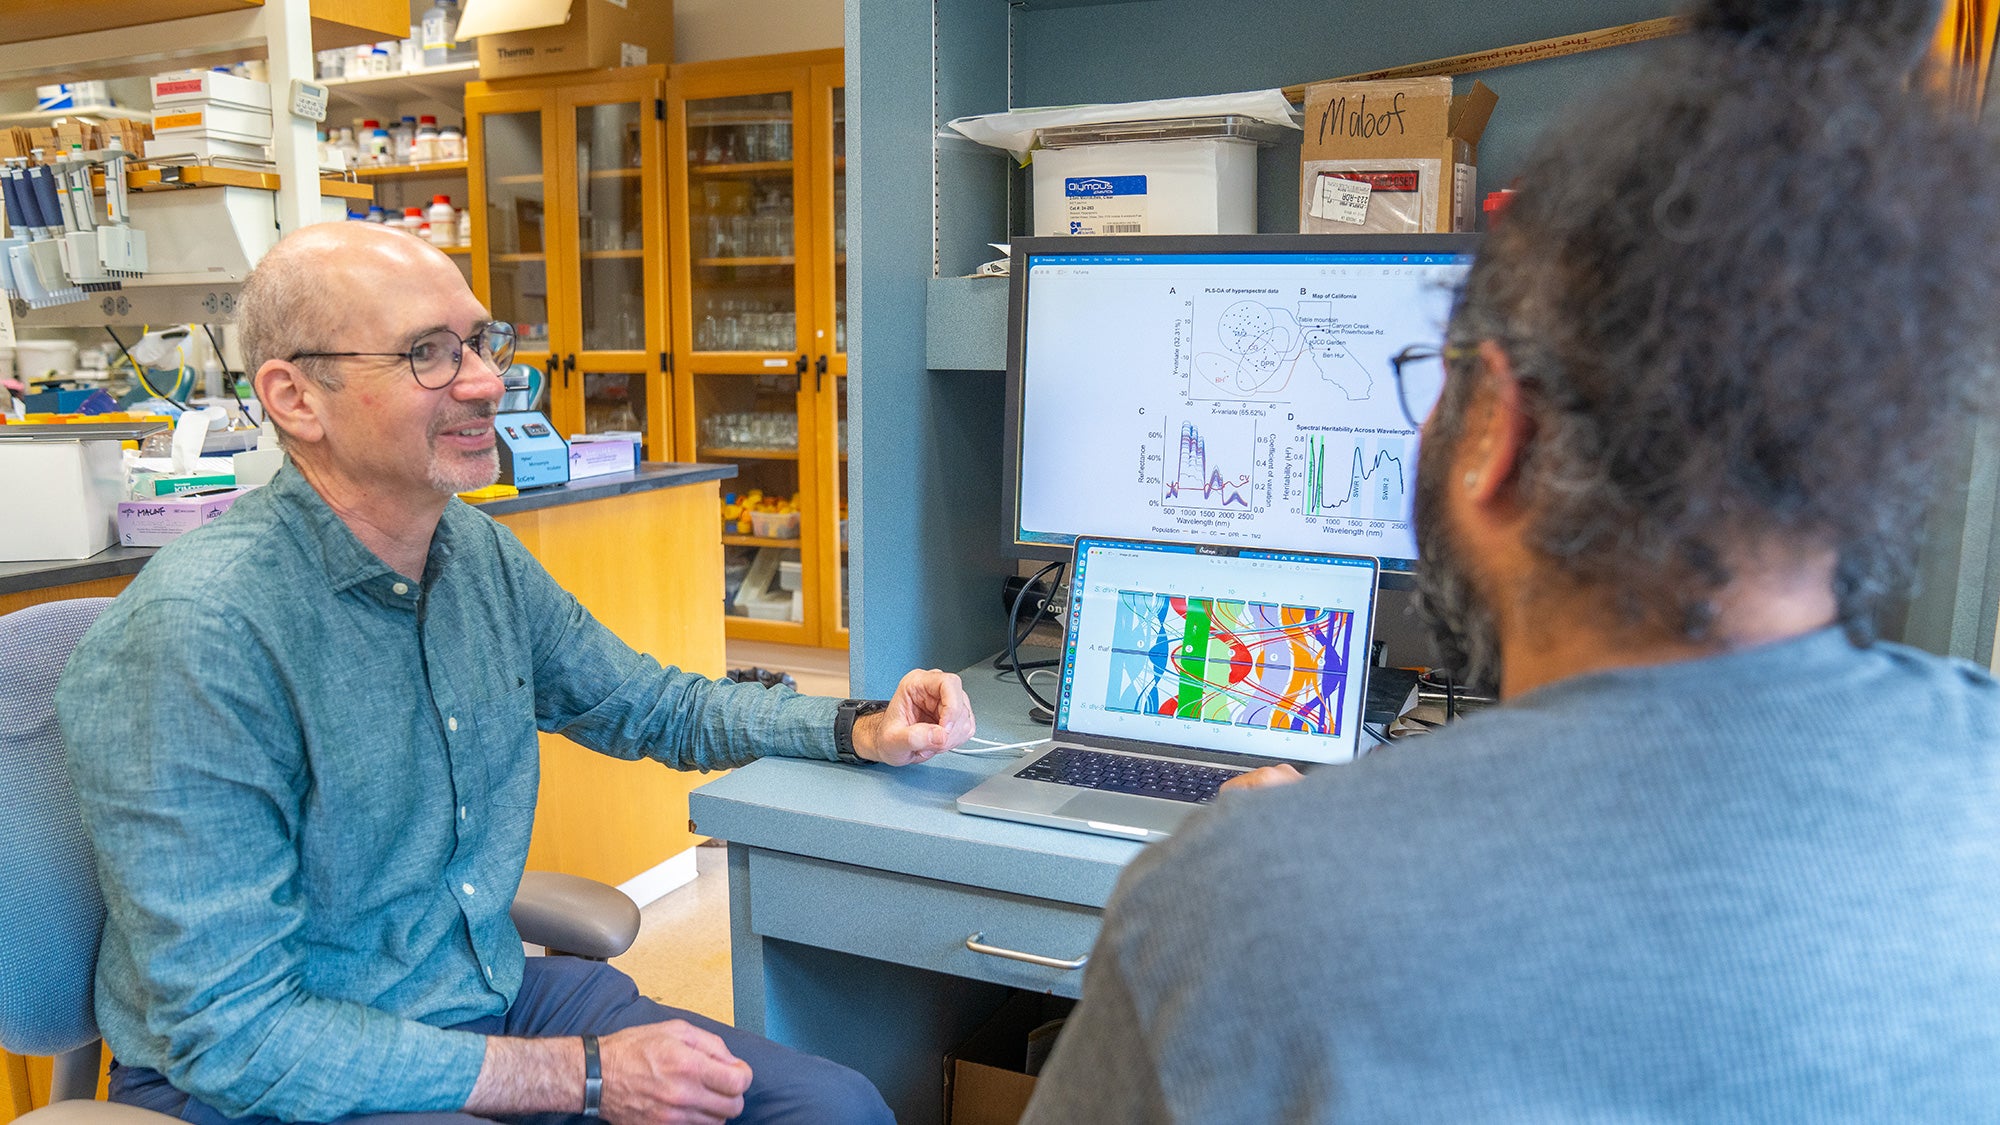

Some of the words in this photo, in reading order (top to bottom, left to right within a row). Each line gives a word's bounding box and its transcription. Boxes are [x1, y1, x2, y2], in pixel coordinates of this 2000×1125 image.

[497, 48, 534, 58] Thermo
[1068, 181, 1114, 192] Olympus
[1374, 176, 1414, 186] ENCLOSED
[1283, 462, 1292, 500] Heritability
[1176, 517, 1213, 526] Wavelength
[1215, 520, 1230, 528] (nm)
[1323, 526, 1364, 536] Wavelength
[1366, 528, 1382, 537] (nm)
